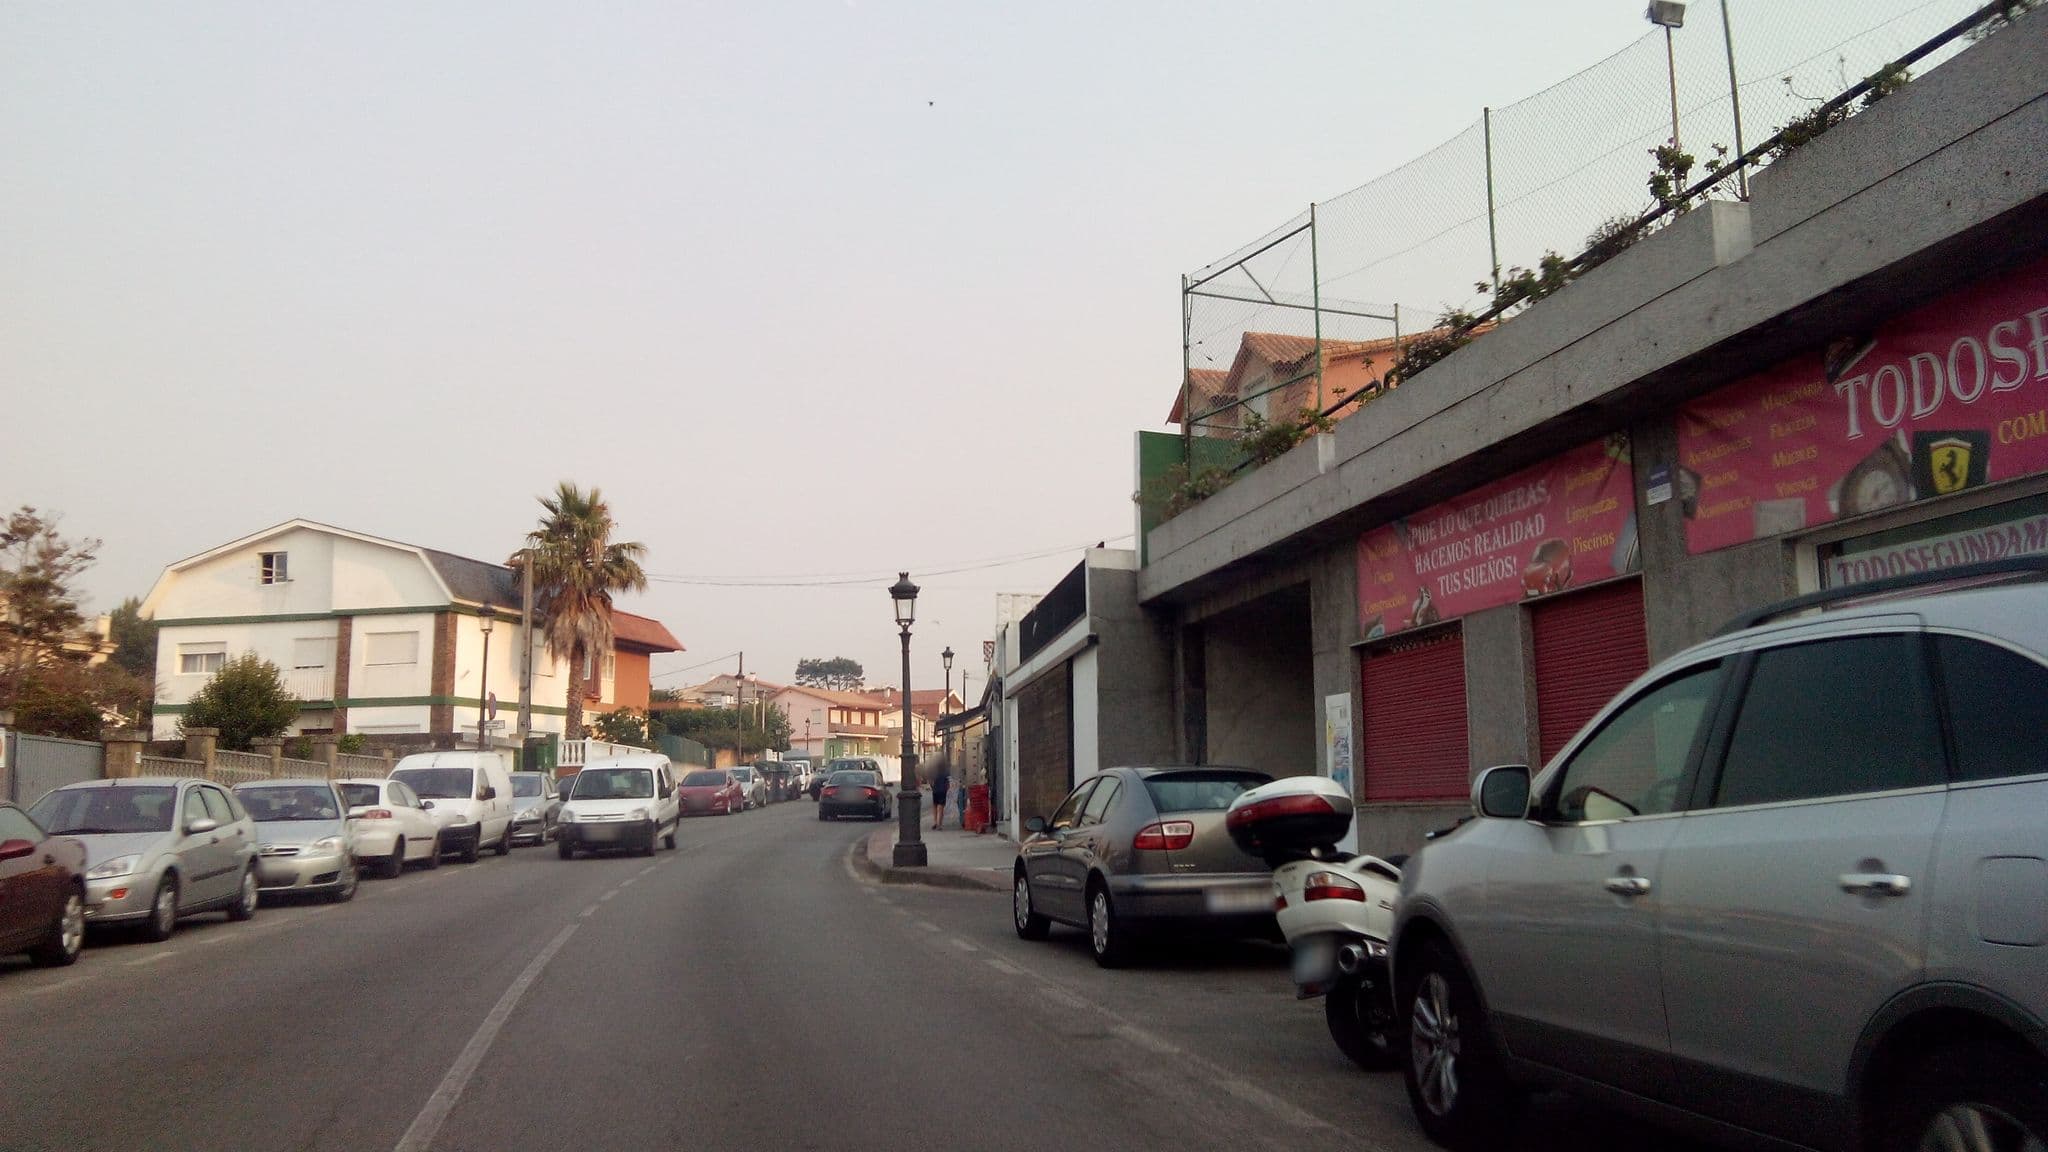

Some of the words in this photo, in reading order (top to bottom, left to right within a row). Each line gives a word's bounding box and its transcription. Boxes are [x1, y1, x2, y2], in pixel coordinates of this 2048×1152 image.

[1439, 514, 1455, 538] LO
[1457, 504, 1482, 533] QUE
[1414, 538, 1472, 576] HACEMOS
[1474, 514, 1545, 557] REALIDAD
[1572, 531, 1616, 557] Piscinas
[1437, 571, 1461, 598] TUS
[1462, 555, 1518, 591] SUEÑOS!
